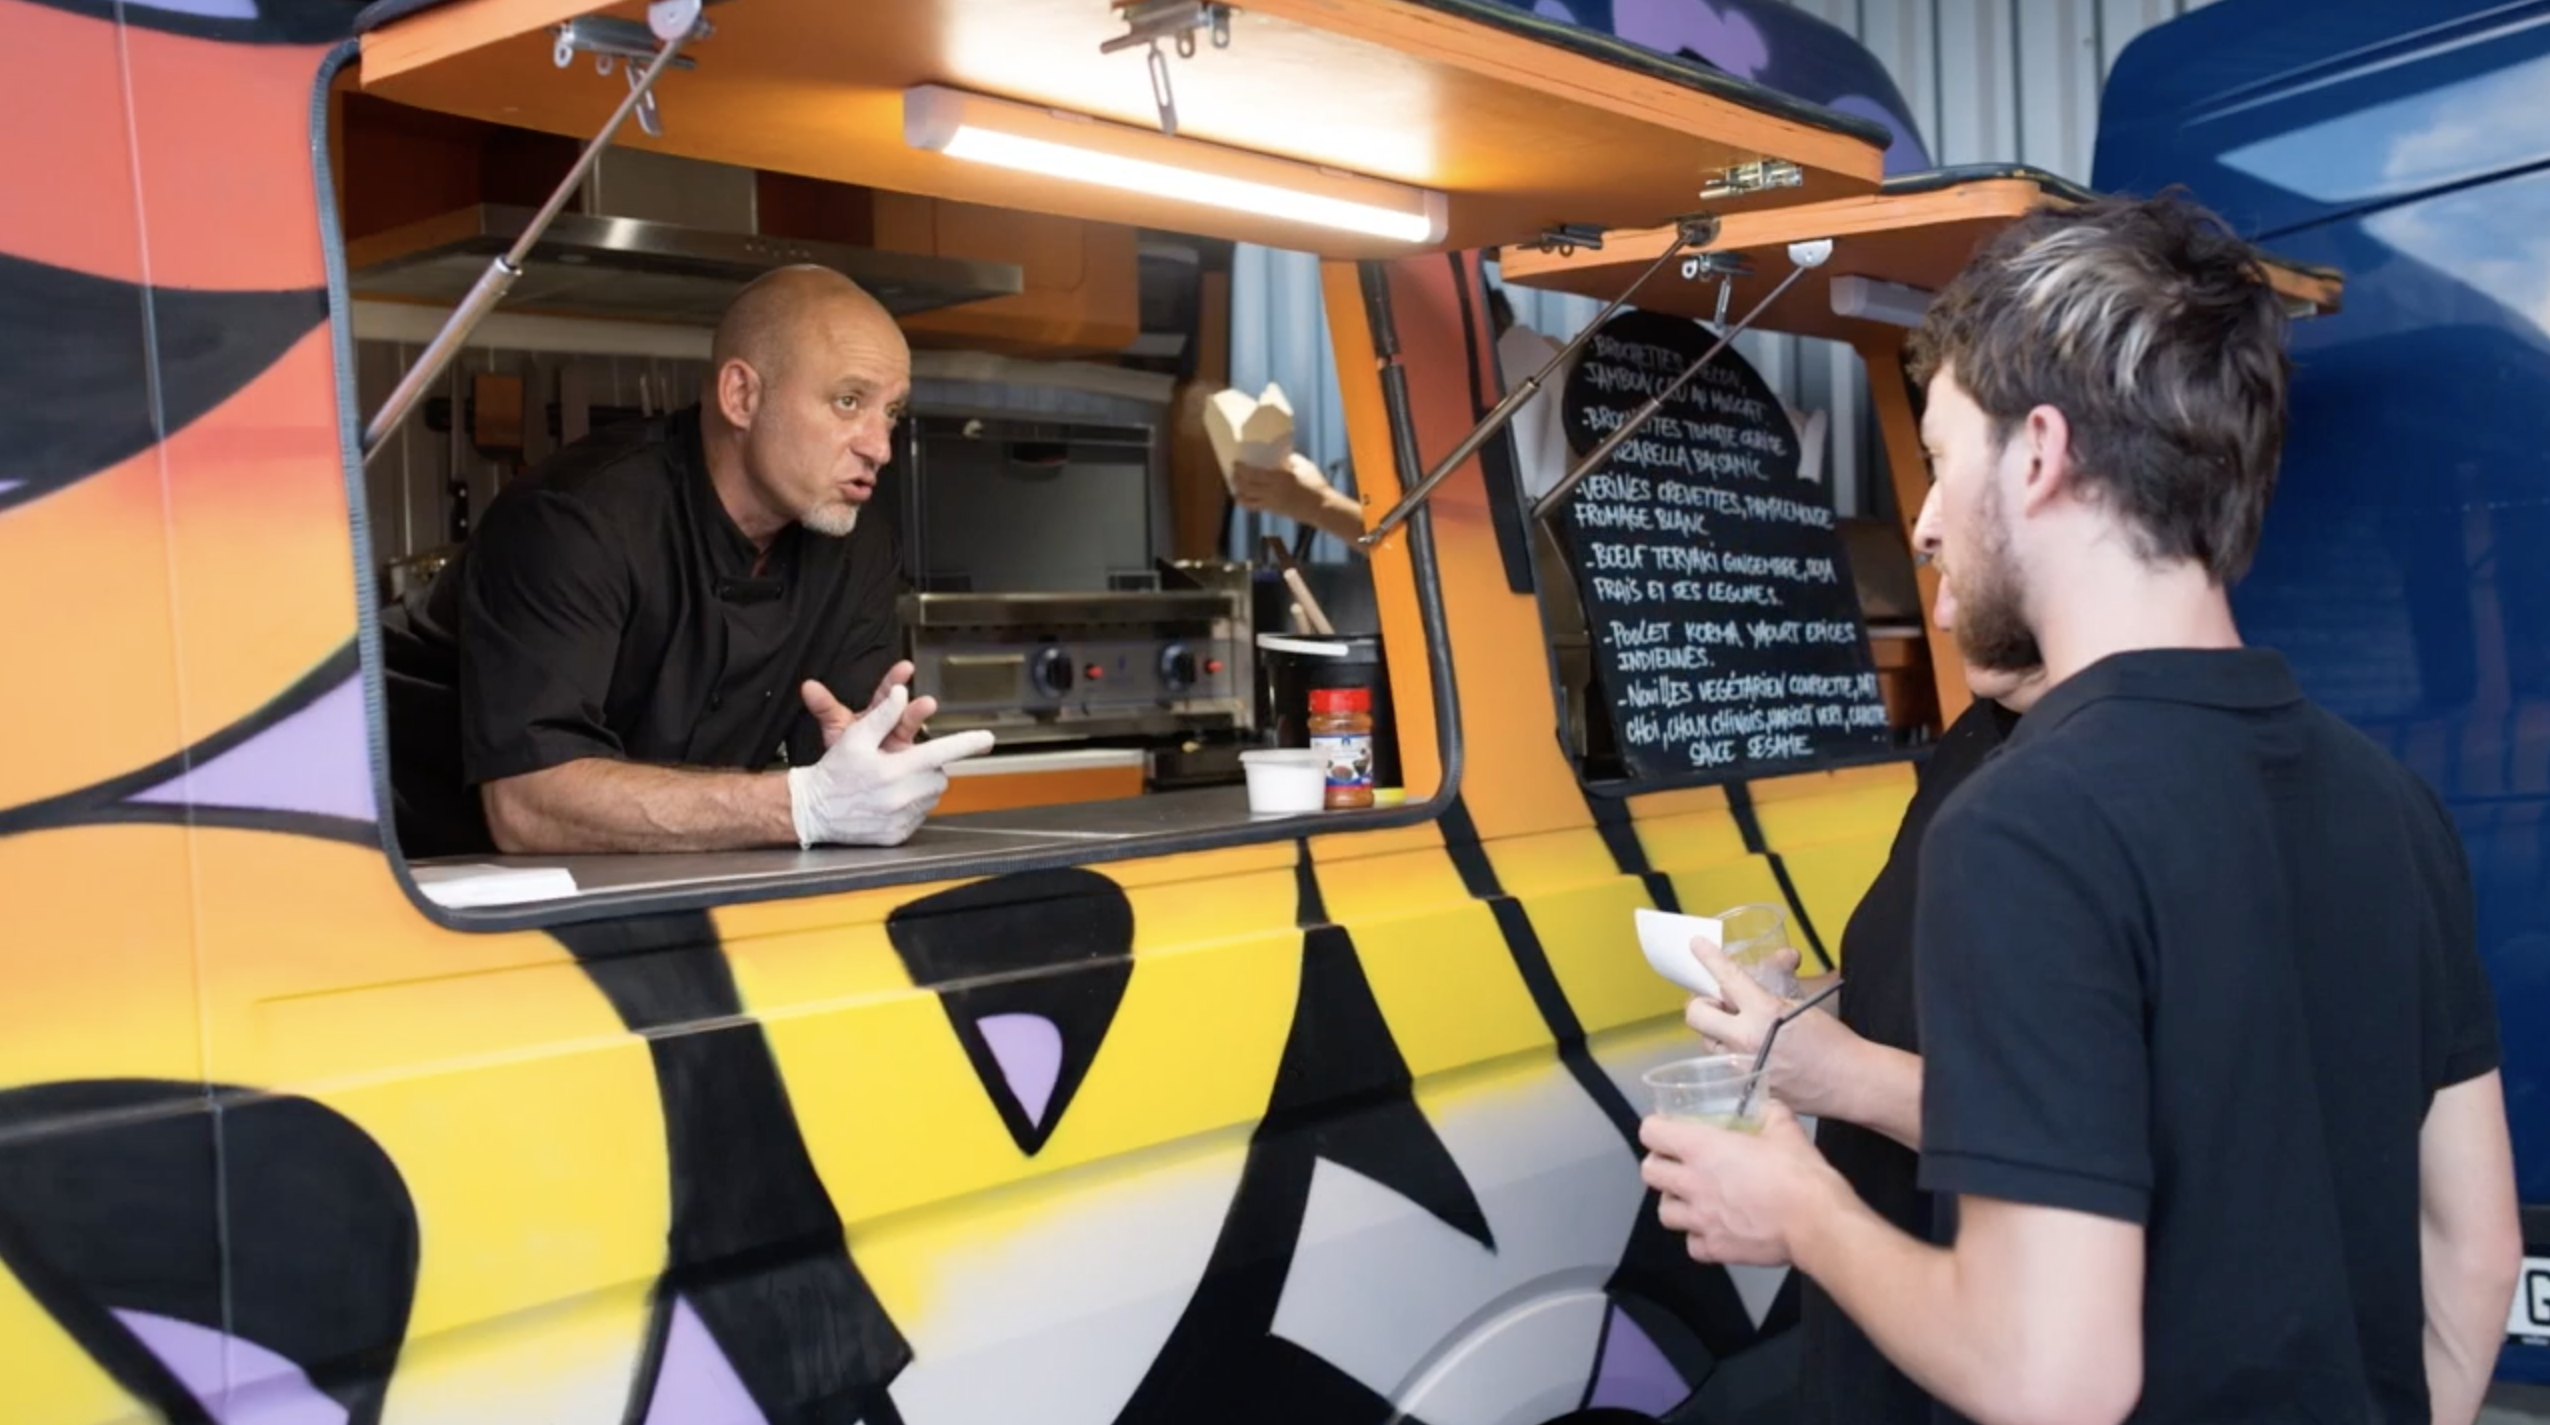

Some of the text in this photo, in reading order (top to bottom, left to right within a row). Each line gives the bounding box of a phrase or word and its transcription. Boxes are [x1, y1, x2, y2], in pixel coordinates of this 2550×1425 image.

[1583, 362, 1655, 395] JAMBON
[1573, 502, 1711, 539] FROMAGE BLANC
[1646, 579, 1667, 604] ET
[1671, 579, 1703, 601] SES
[1684, 619, 1745, 649] KORMA
[1745, 619, 1802, 651] YAOURT
[1689, 733, 1816, 768] SAUCE SESAME
